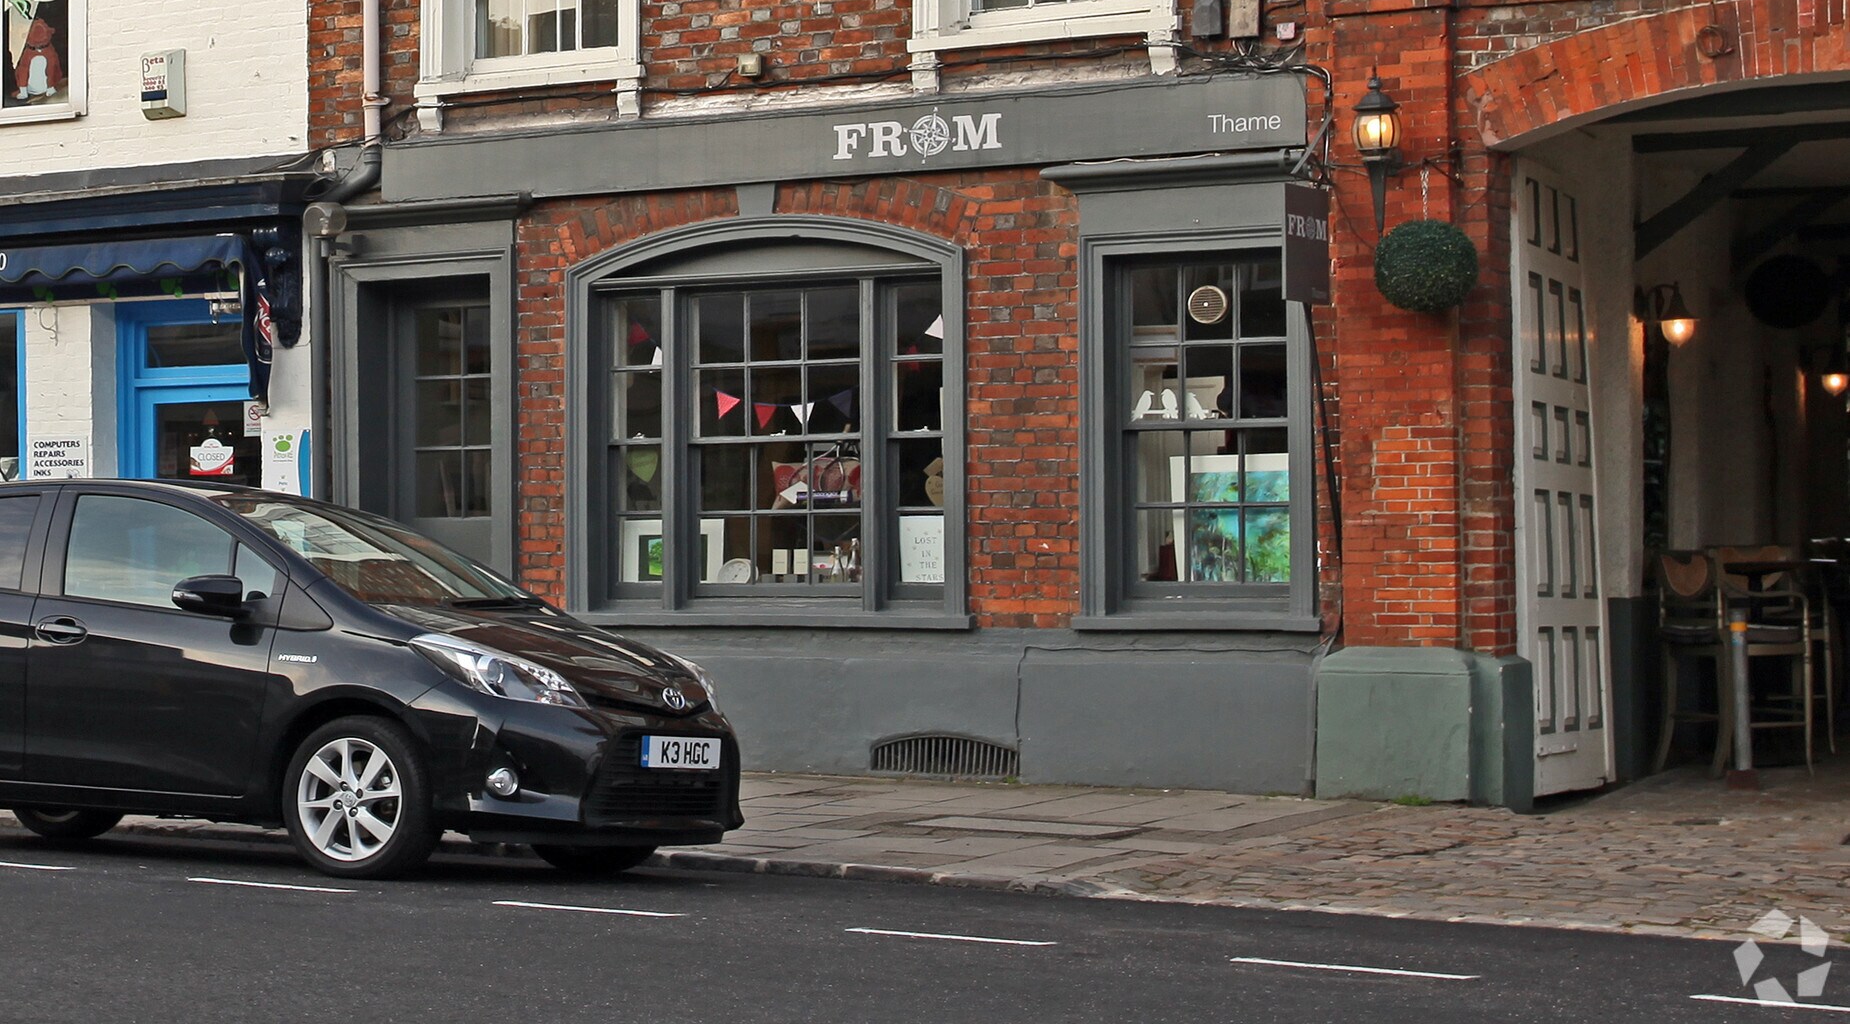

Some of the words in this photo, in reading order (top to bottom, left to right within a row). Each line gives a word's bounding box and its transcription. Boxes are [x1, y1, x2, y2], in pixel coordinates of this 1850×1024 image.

[1207, 114, 1281, 133] Thame
[833, 110, 1002, 162] FROM
[1287, 213, 1328, 241] FROM
[33, 440, 81, 449] COMPUTERS
[33, 450, 66, 458] REPAIRS
[197, 452, 226, 462] CLOSED
[33, 459, 84, 468] ACCESSORIES
[33, 468, 52, 477] INKS
[914, 537, 937, 545] LOST
[921, 550, 932, 558] IN
[919, 561, 937, 569] THE
[660, 741, 681, 764] K3
[683, 742, 710, 765] HGC
